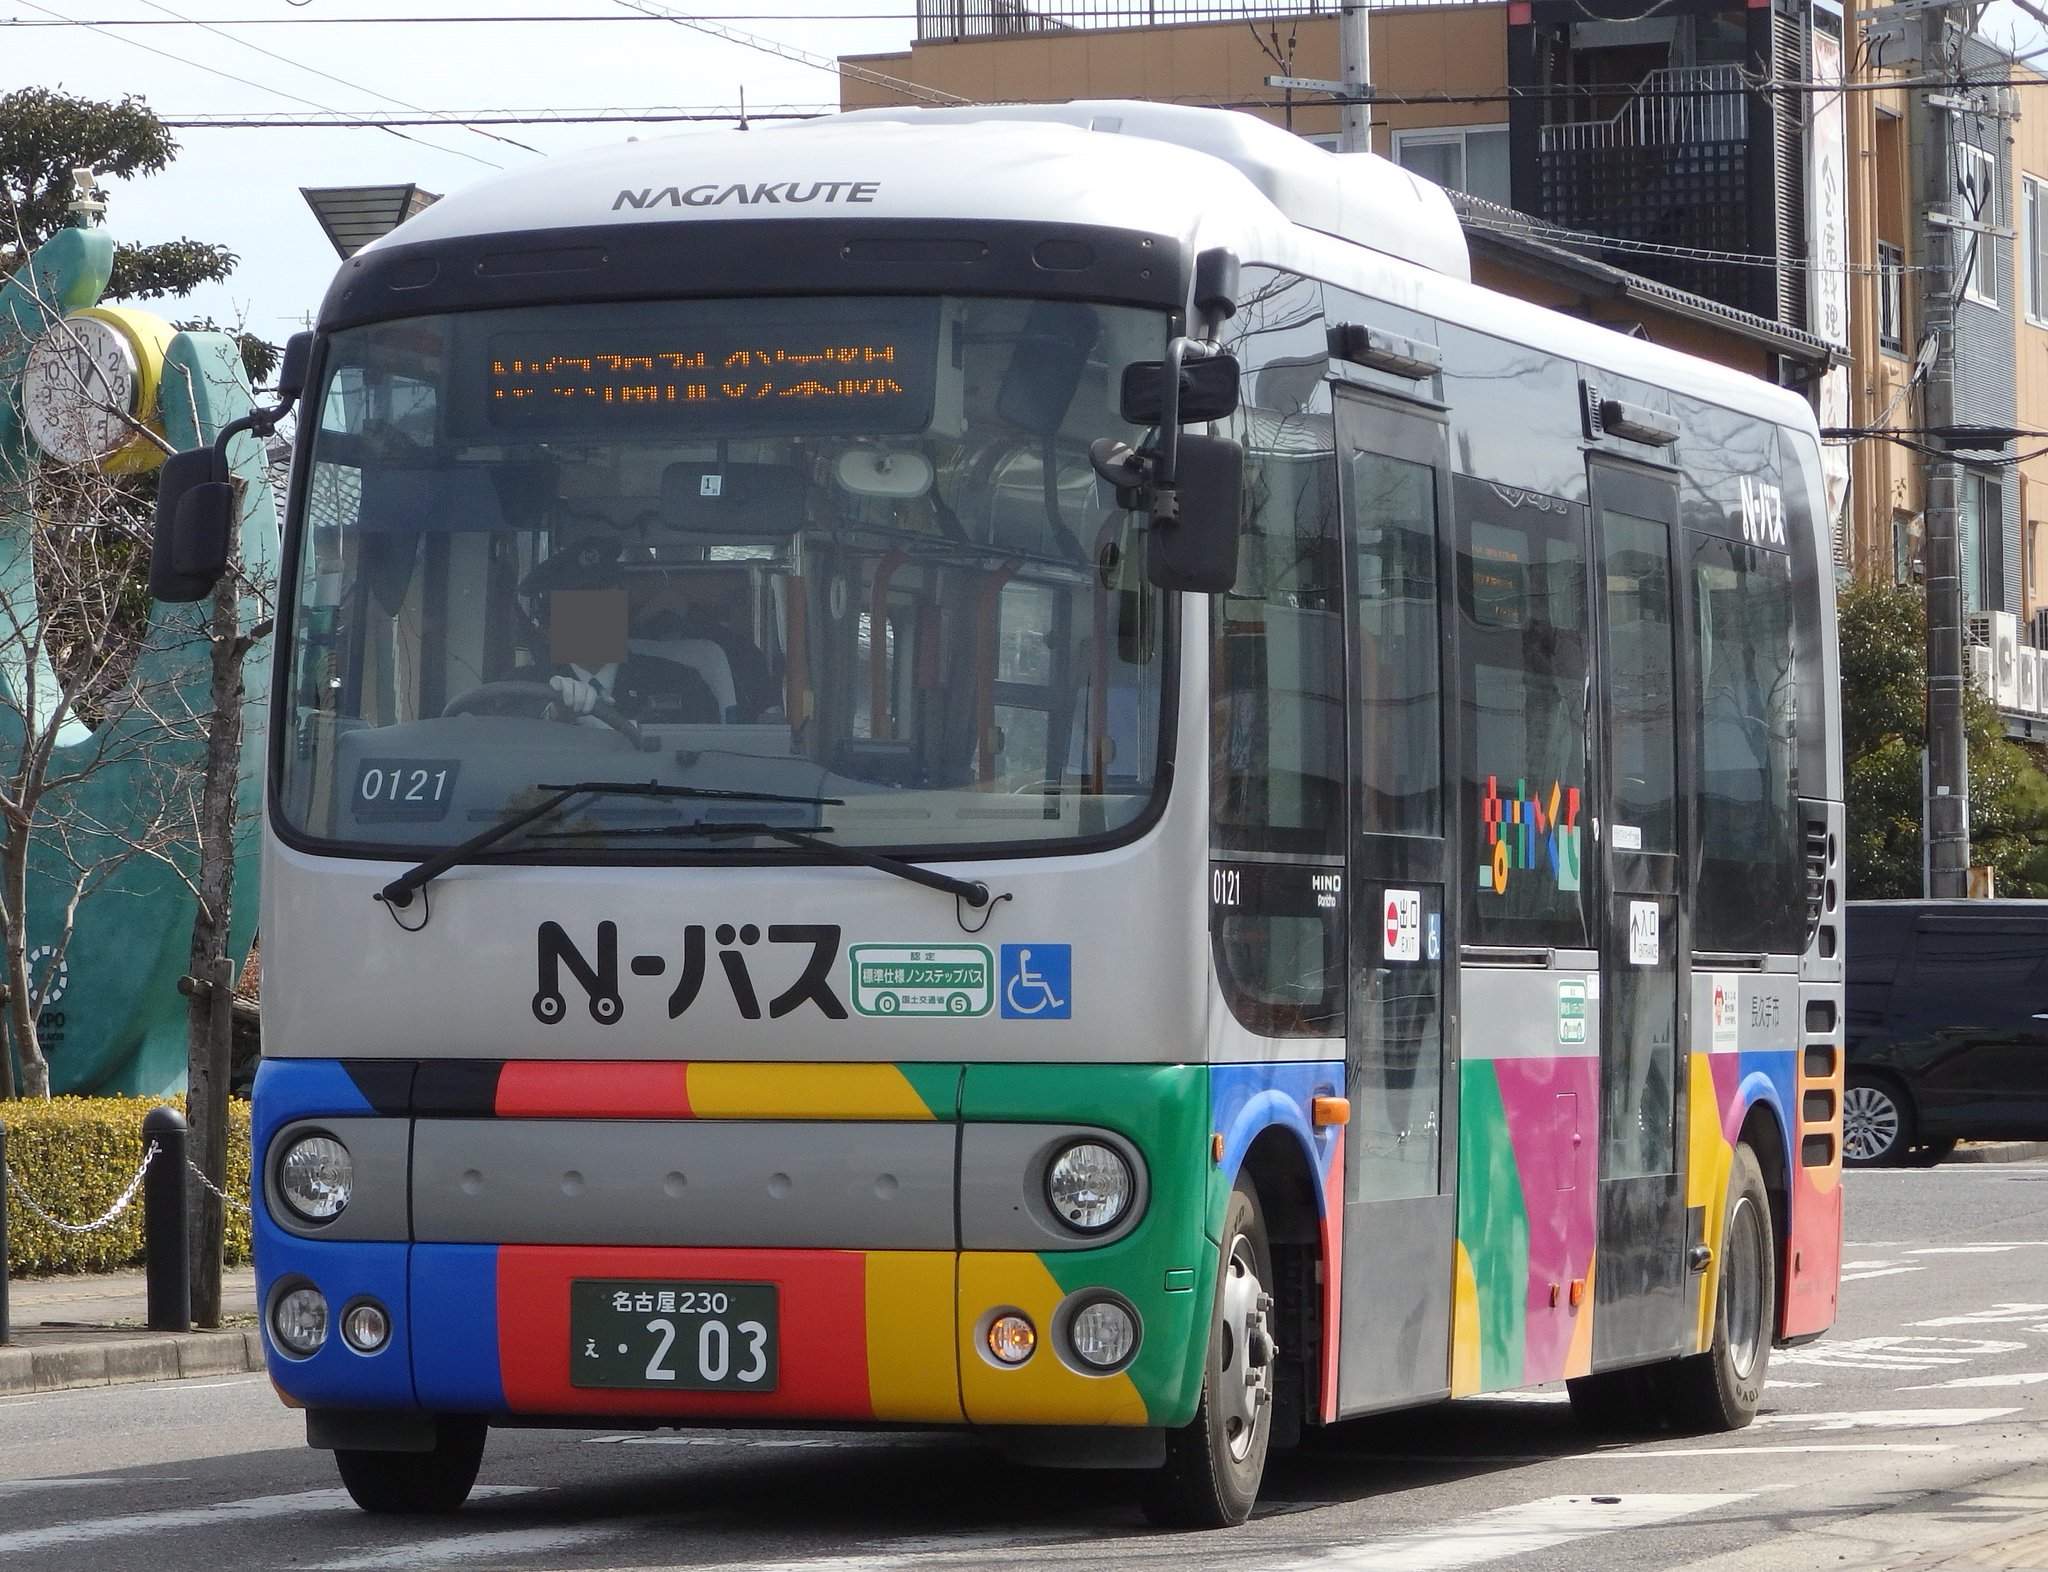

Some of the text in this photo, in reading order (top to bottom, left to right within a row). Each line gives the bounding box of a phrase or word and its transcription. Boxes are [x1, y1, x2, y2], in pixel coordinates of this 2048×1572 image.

[611, 181, 881, 211] NAGAKUTE
[41, 361, 60, 381] 10
[108, 352, 119, 372] 2
[1739, 475, 1786, 546] N-バス
[362, 769, 447, 801] 0121
[1213, 869, 1241, 905] 0121
[1312, 874, 1341, 893] HINO
[1400, 898, 1418, 929] 出口
[1640, 909, 1656, 937] 入口
[532, 920, 849, 1025] N-バス
[862, 968, 983, 985] 標準仕様ノンステップバス
[901, 995, 945, 1004] 国土交通省
[954, 1000, 964, 1010] 5
[1751, 996, 1780, 1028] 長久手市
[612, 1290, 728, 1314] 名古屋 230
[584, 1338, 600, 1359] え
